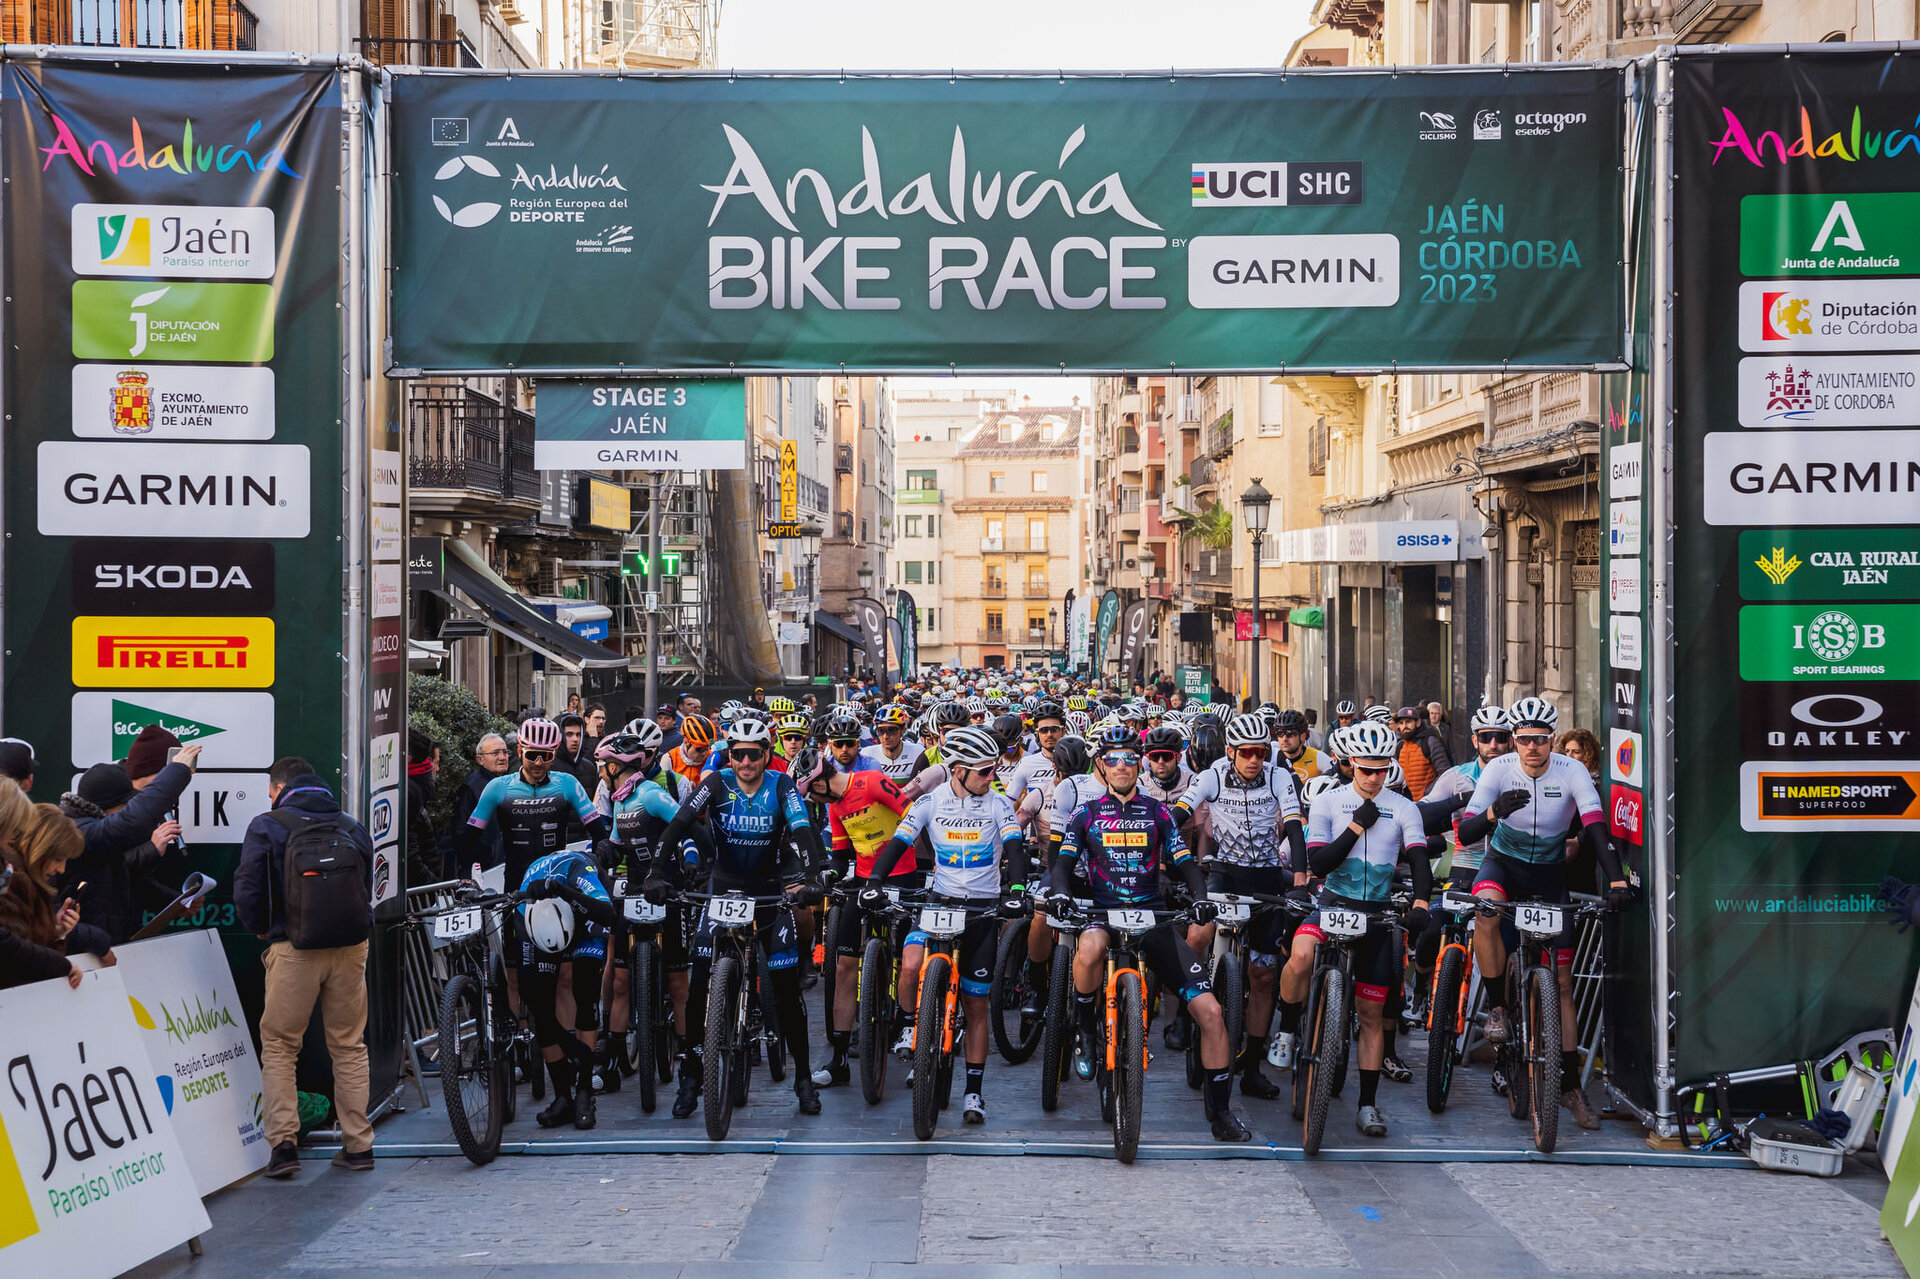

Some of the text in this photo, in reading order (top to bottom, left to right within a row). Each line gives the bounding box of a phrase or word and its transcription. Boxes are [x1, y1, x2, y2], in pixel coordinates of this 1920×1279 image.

[1515, 112, 1587, 132] octagon
[1515, 126, 1551, 136] esedos
[40, 113, 304, 179] Andalucía
[507, 140, 535, 148] Andalucía
[1419, 133, 1457, 141] CICLISMO
[510, 163, 628, 192] Andalucía
[699, 123, 1165, 233] Andalucía
[1208, 170, 1280, 200] UCI
[1299, 171, 1351, 195] SHC
[510, 197, 628, 211] Región Europea del
[510, 211, 585, 223] DEPORTE
[1419, 199, 1504, 234] JAÉN
[162, 217, 250, 255] Jaén
[1172, 238, 1188, 248] BY
[163, 255, 250, 268] Paraíso interior
[1419, 235, 1581, 270] CÓRDOBA
[1213, 257, 1376, 285] GARMIN
[1781, 254, 1900, 270] Junta de Andalucía
[709, 236, 1167, 311] BIKE RACE
[1419, 274, 1497, 303] 2023
[1822, 301, 1918, 319] Diputación
[150, 319, 220, 331] DIPUTACIÓN
[1821, 319, 1918, 336] de Córdoba
[150, 331, 197, 344] DE JAÉN
[1816, 371, 1916, 389] AYUNTAMIENTO
[161, 393, 205, 404] EXCMO.
[592, 387, 687, 407] STAGE 3
[1815, 394, 1829, 411] DE
[162, 404, 249, 415] AYUNTAMIENTO
[161, 414, 212, 426] DE JAÉN
[611, 411, 667, 434] JAÉN
[597, 449, 679, 463] GARMIN
[63, 472, 278, 507] GARMIN
[782, 442, 796, 519] AMATE
[1397, 534, 1439, 547] asisa
[1810, 551, 1920, 567] CAJA RURAL
[1842, 568, 1888, 585] JAÉN
[97, 636, 249, 668] PIRELLI
[1793, 665, 1885, 675] SPORT BEARINGS
[114, 721, 128, 735] El
[1767, 731, 1907, 747] OAKLEY
[1787, 785, 1892, 798] NAMEDSPORT
[1799, 801, 1867, 809] SUPERFOOD
[1095, 819, 1155, 830] Wilier
[718, 900, 747, 919] 15-2
[1120, 911, 1145, 924] 1-2
[1523, 908, 1554, 928] 94-1
[443, 912, 473, 933] 15-1
[933, 911, 952, 927] 1-1
[1327, 911, 1360, 930] 94-2
[160, 988, 239, 1046] Andalucía
[174, 1040, 248, 1080] Región Europea del
[181, 1071, 230, 1104] DEPORTE
[8, 1041, 154, 1182] Jaén
[48, 1151, 166, 1218] Paraíso interior
